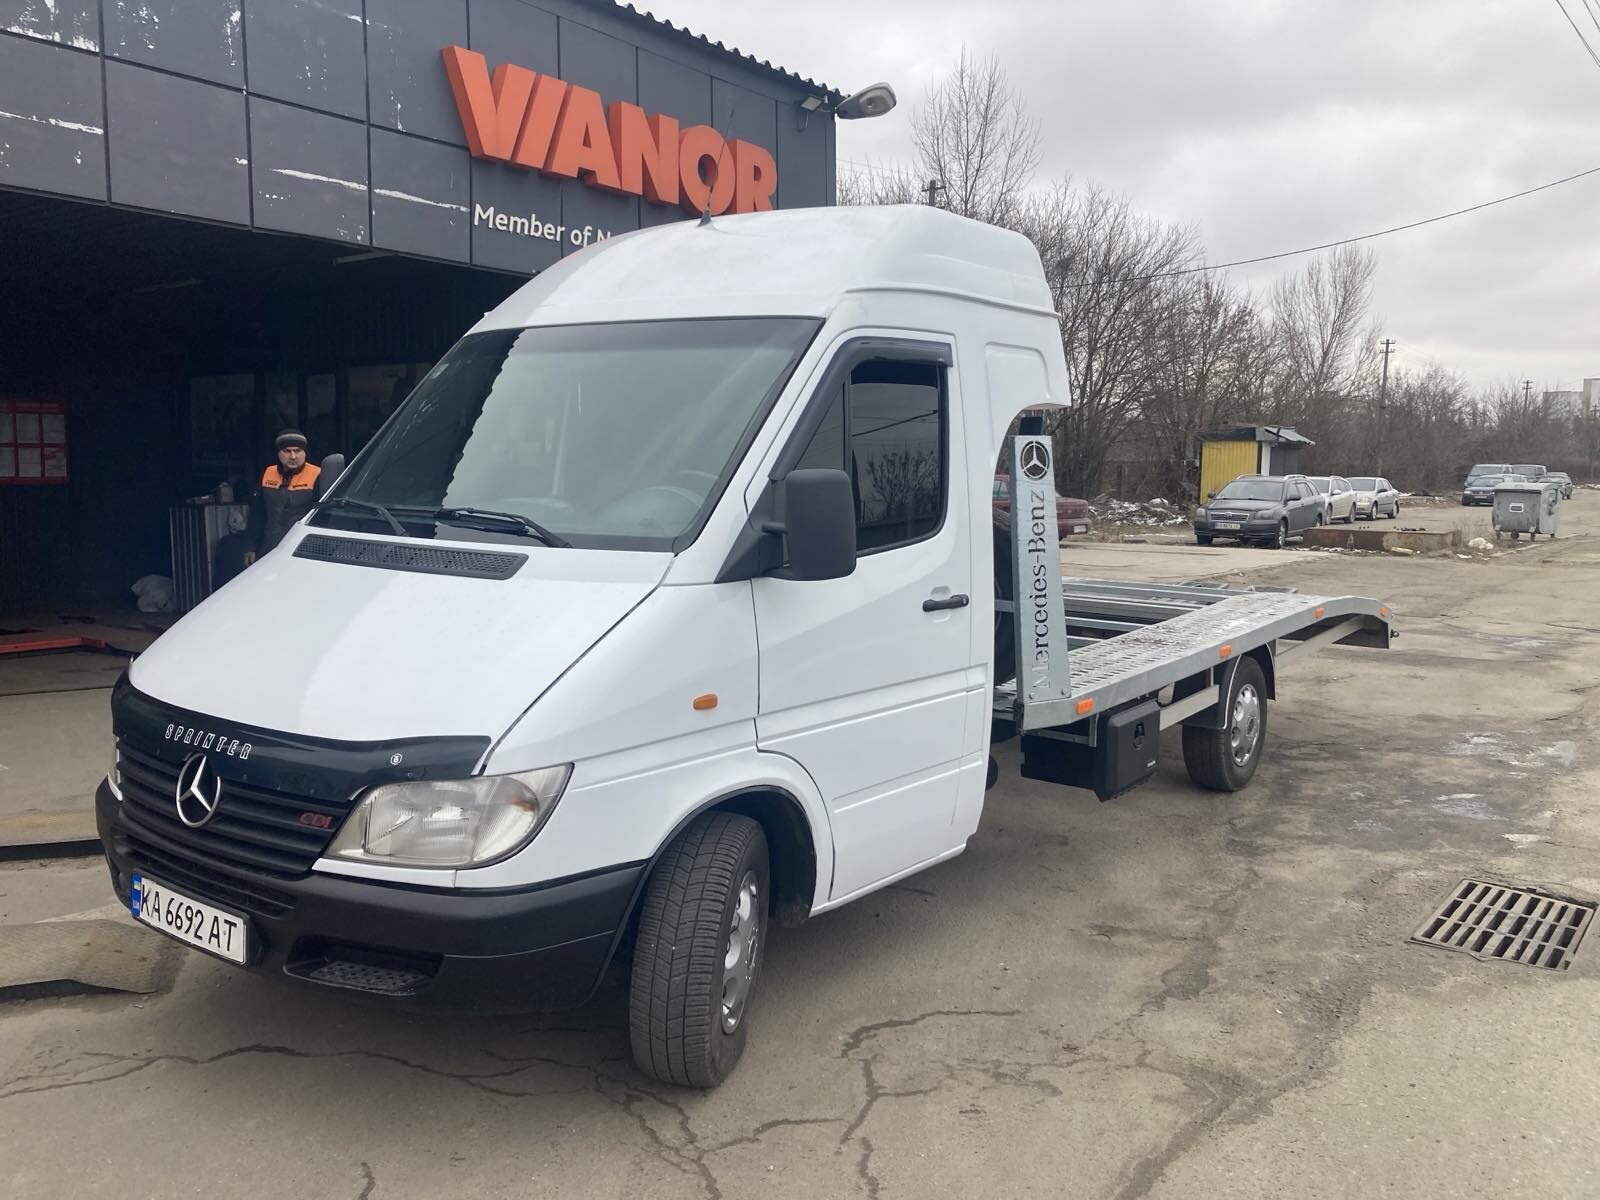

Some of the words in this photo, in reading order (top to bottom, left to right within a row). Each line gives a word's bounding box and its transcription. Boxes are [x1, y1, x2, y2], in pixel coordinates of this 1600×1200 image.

[440, 45, 777, 217] VIANOR
[474, 203, 564, 242] Member
[570, 225, 593, 248] of
[1028, 489, 1051, 689] Mercedes-Benz
[165, 723, 252, 760] SPRINTER
[300, 812, 333, 829] CDI
[140, 884, 162, 922] KA
[165, 897, 203, 940] 6692
[208, 915, 238, 952] AT
